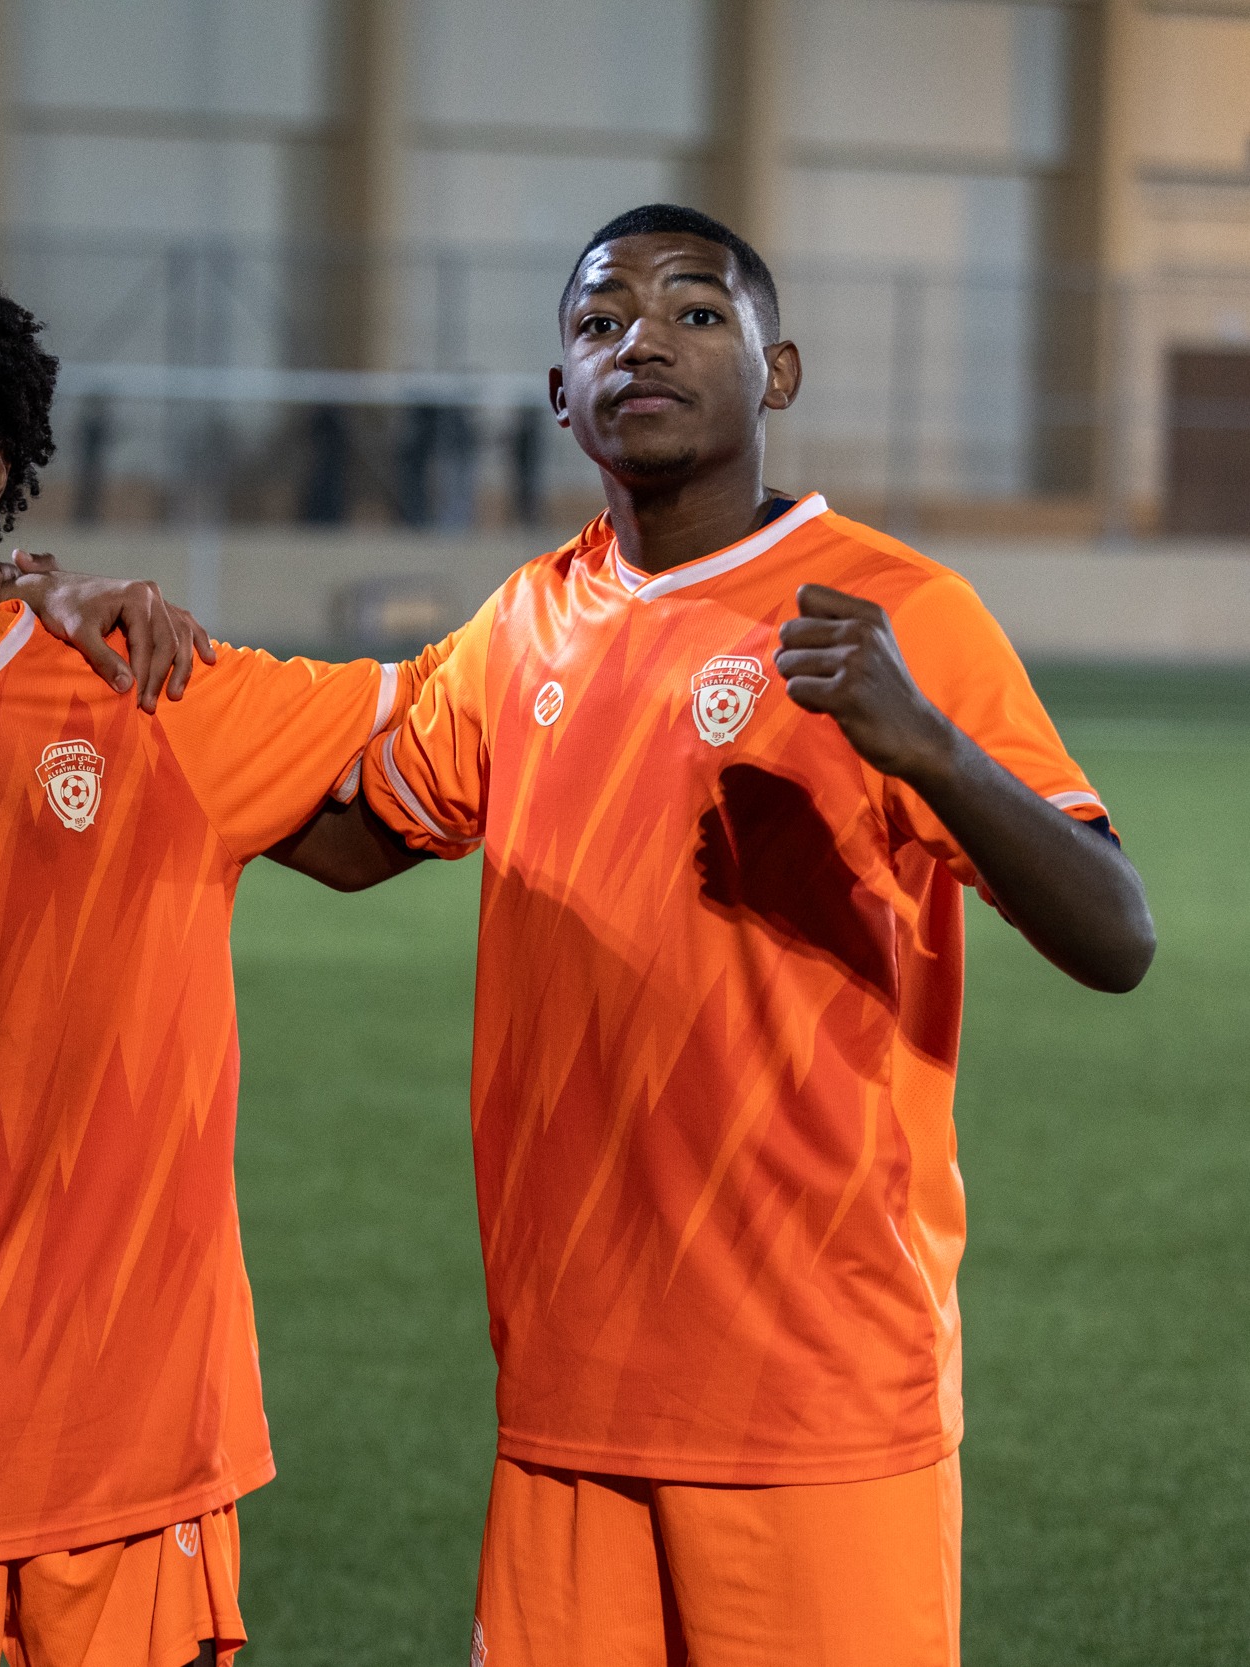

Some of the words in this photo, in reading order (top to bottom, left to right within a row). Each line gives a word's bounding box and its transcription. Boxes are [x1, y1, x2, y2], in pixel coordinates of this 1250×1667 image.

[700, 679, 733, 688] ALFAYHA
[737, 680, 754, 691] CLUB
[48, 765, 76, 780] ALFAYHA
[78, 765, 95, 773] CLUB
